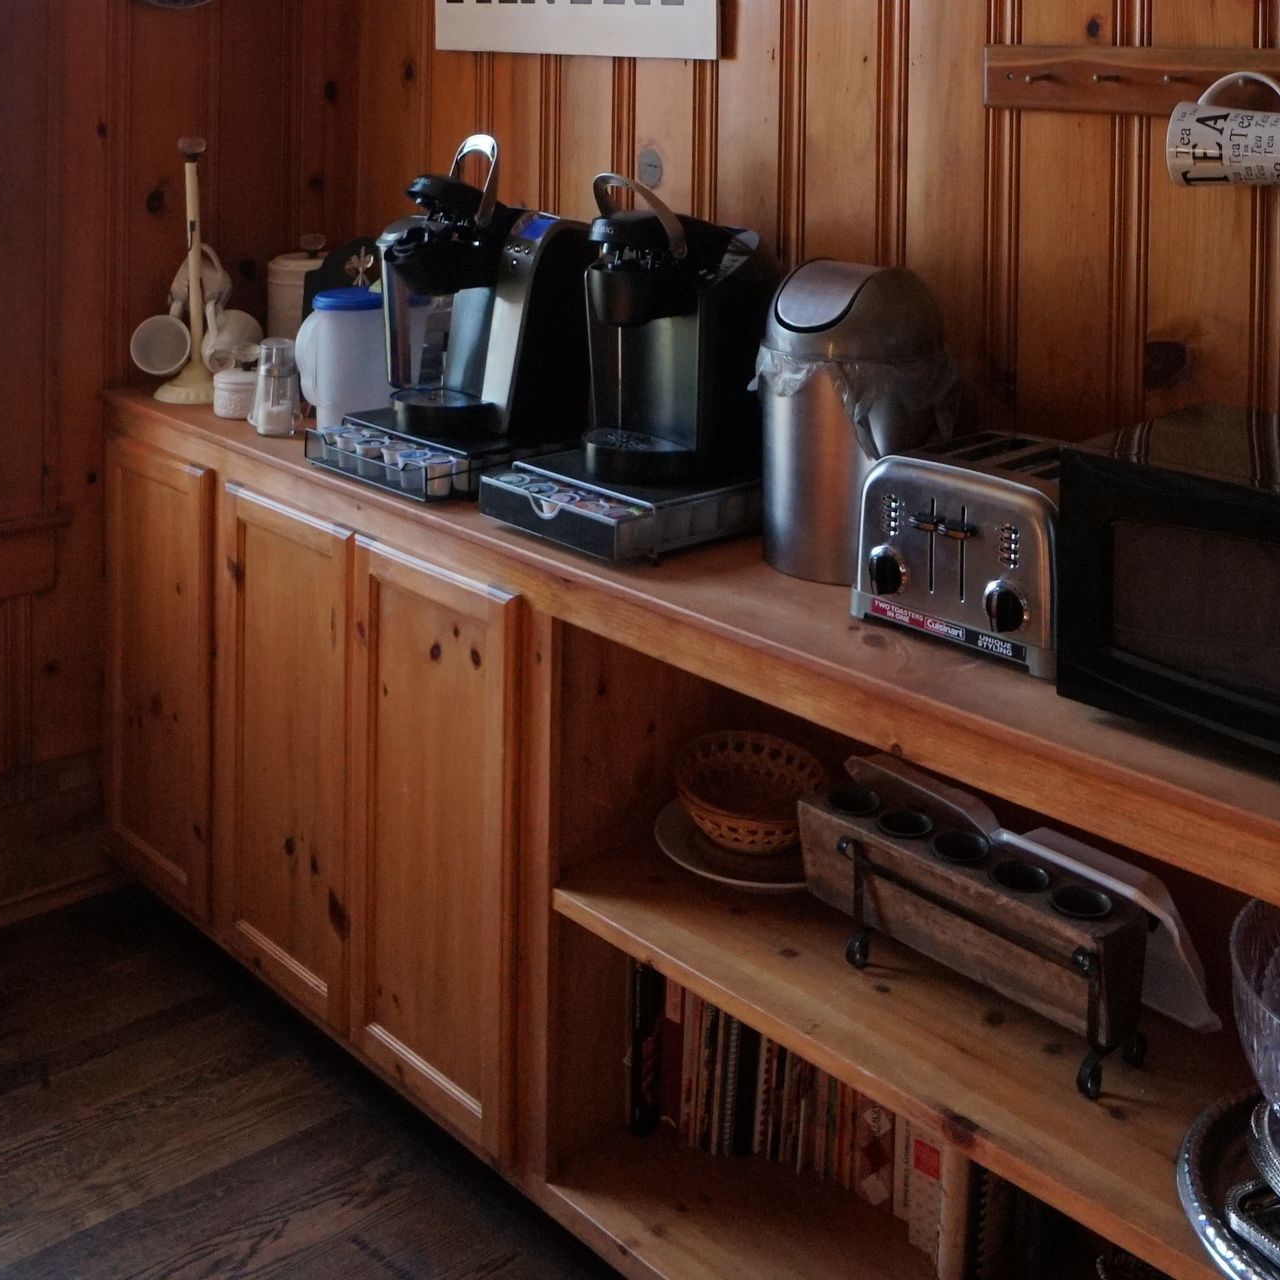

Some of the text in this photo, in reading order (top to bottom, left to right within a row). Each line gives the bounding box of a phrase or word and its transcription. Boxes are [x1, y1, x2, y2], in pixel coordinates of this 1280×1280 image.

[1229, 115, 1254, 141] Tea
[1176, 128, 1191, 158] Tea
[1182, 112, 1230, 185] TEA
[1251, 136, 1262, 155] Tea
[1264, 136, 1274, 155] Tea
[1229, 143, 1241, 166] Tea
[874, 600, 924, 622] TWO TOASTERS
[895, 613, 910, 623] ONE
[926, 618, 964, 638] Cuisinart
[977, 640, 1013, 657] STYLING
[979, 634, 1012, 650] UNIQUE
